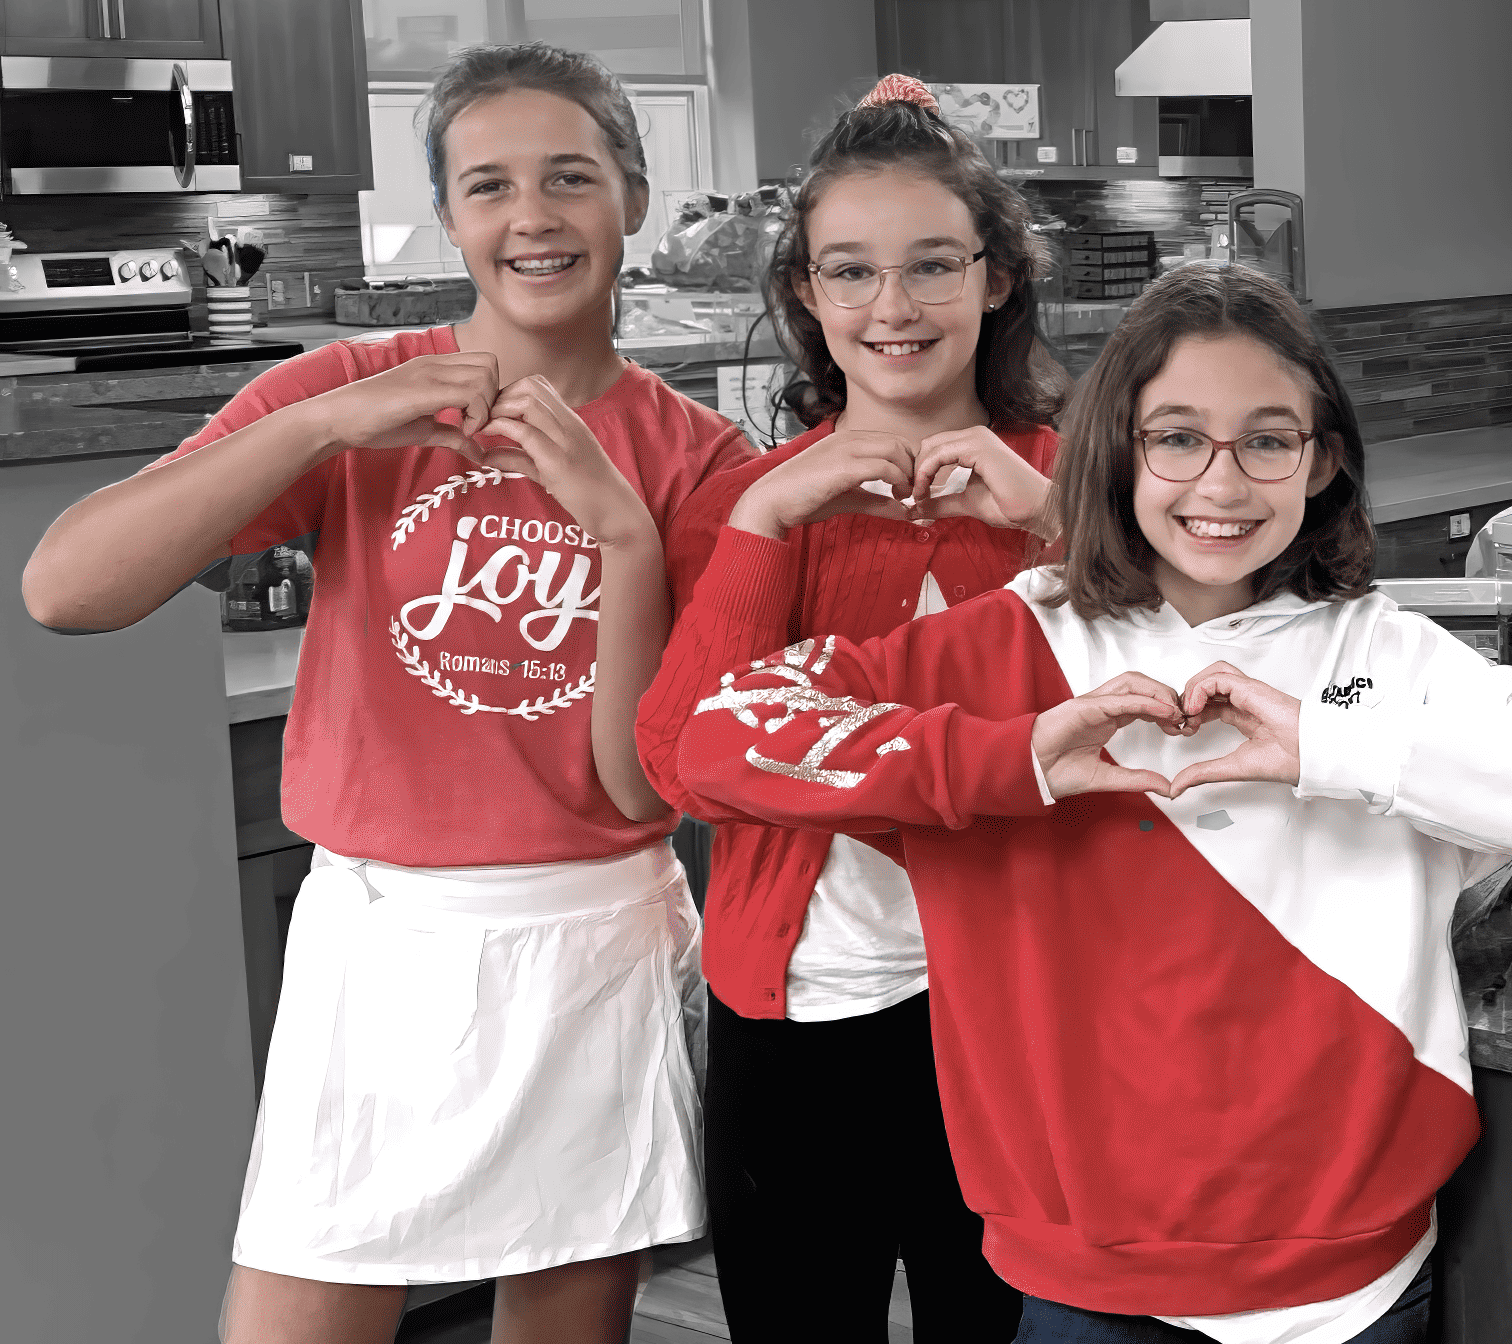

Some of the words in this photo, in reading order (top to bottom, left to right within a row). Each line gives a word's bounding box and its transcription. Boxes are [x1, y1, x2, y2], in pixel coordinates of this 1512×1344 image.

[480, 514, 599, 549] CHOOSE
[400, 516, 602, 652] joy
[439, 651, 510, 676] Romans
[521, 659, 567, 681] 15:13
